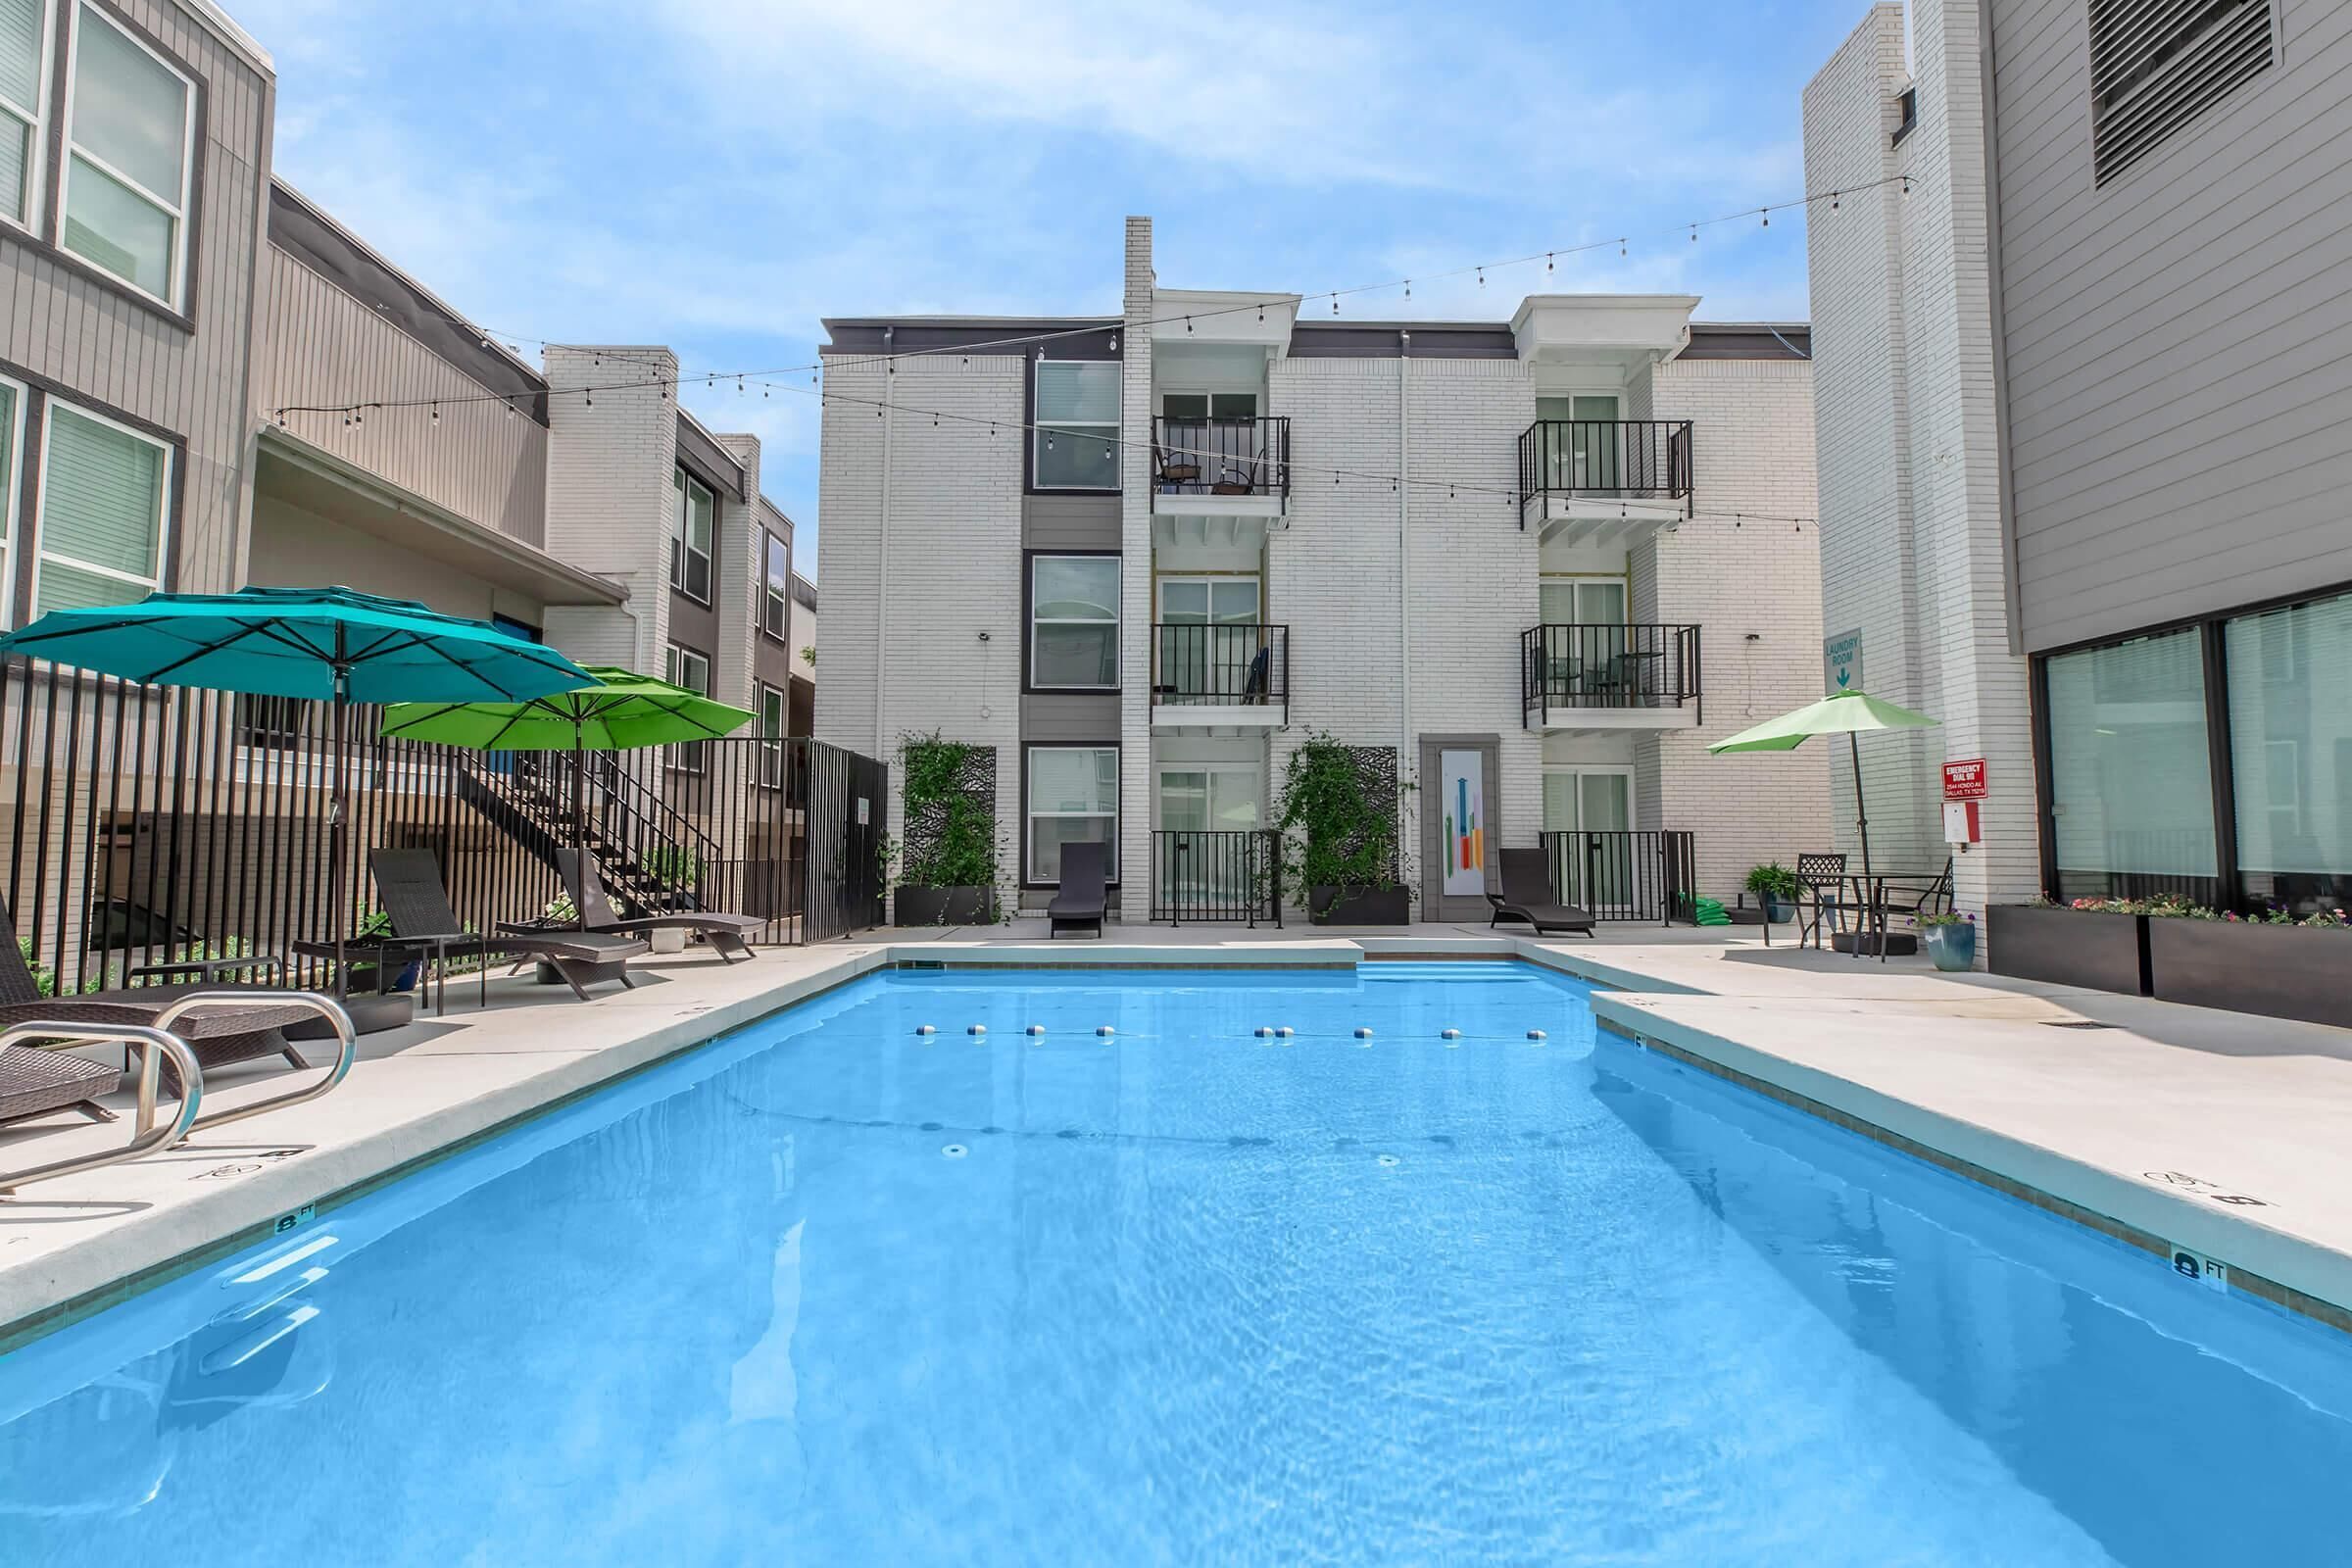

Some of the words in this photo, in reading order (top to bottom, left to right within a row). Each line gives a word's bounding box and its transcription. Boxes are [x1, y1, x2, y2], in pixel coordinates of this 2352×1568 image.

[1827, 637, 1858, 656] LAUNDRY
[1833, 651, 1853, 666] ROOM
[1946, 764, 1981, 775] EMERGENCY
[276, 1214, 297, 1233] 8
[301, 1204, 314, 1216] FT
[2174, 1251, 2200, 1280] 8
[2206, 1260, 2224, 1279] FT
